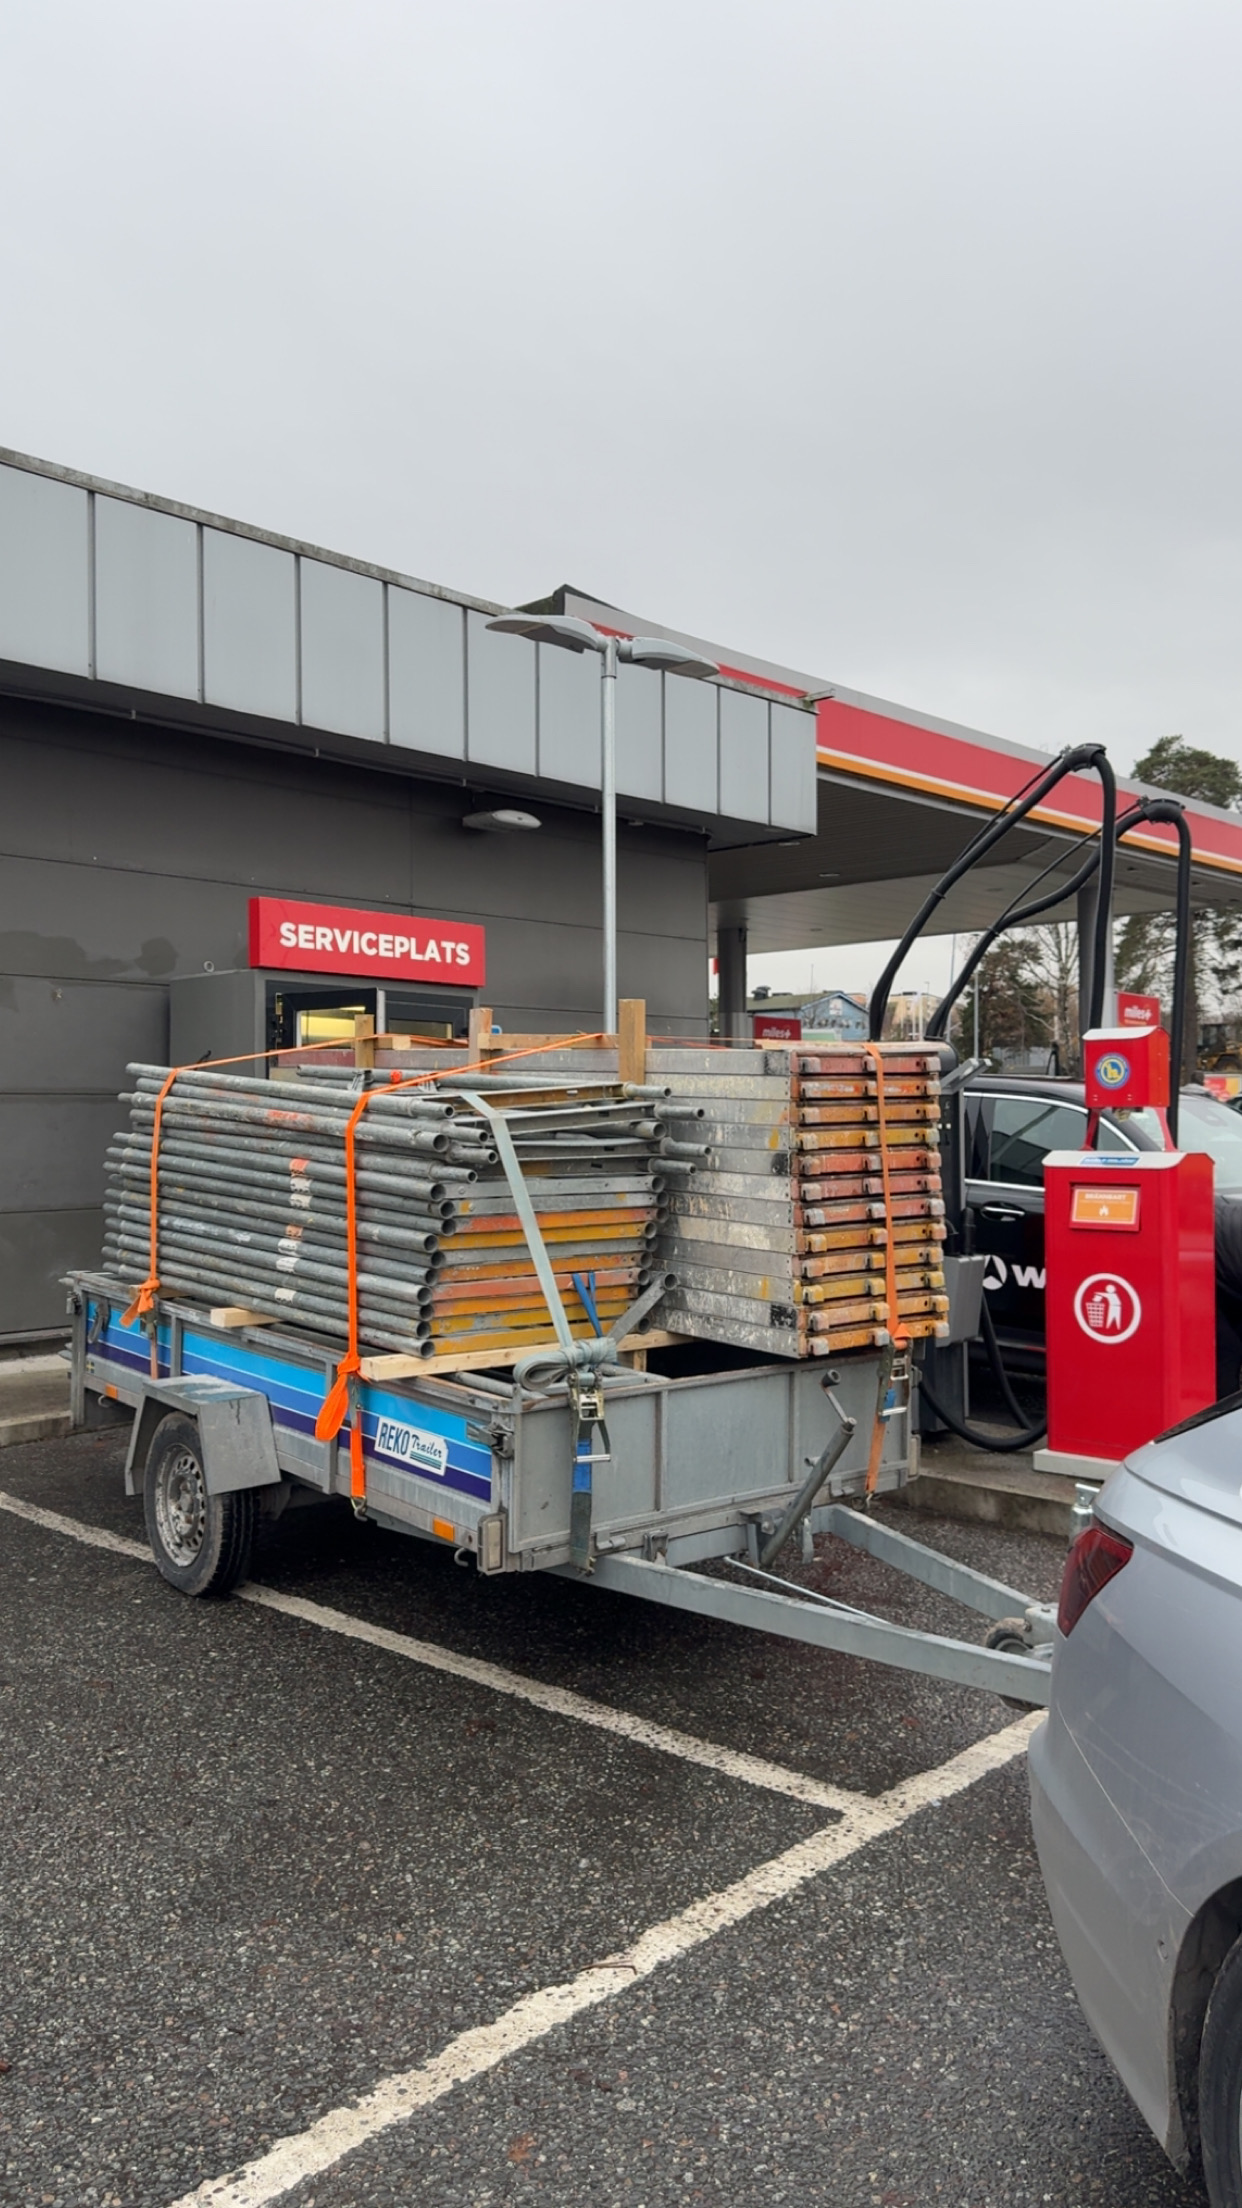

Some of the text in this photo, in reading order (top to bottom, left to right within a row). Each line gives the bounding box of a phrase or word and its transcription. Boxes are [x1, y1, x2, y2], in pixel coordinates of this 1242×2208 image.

[280, 922, 470, 965] SERVICEPLATS
[378, 1422, 442, 1458] REKO Trailer
